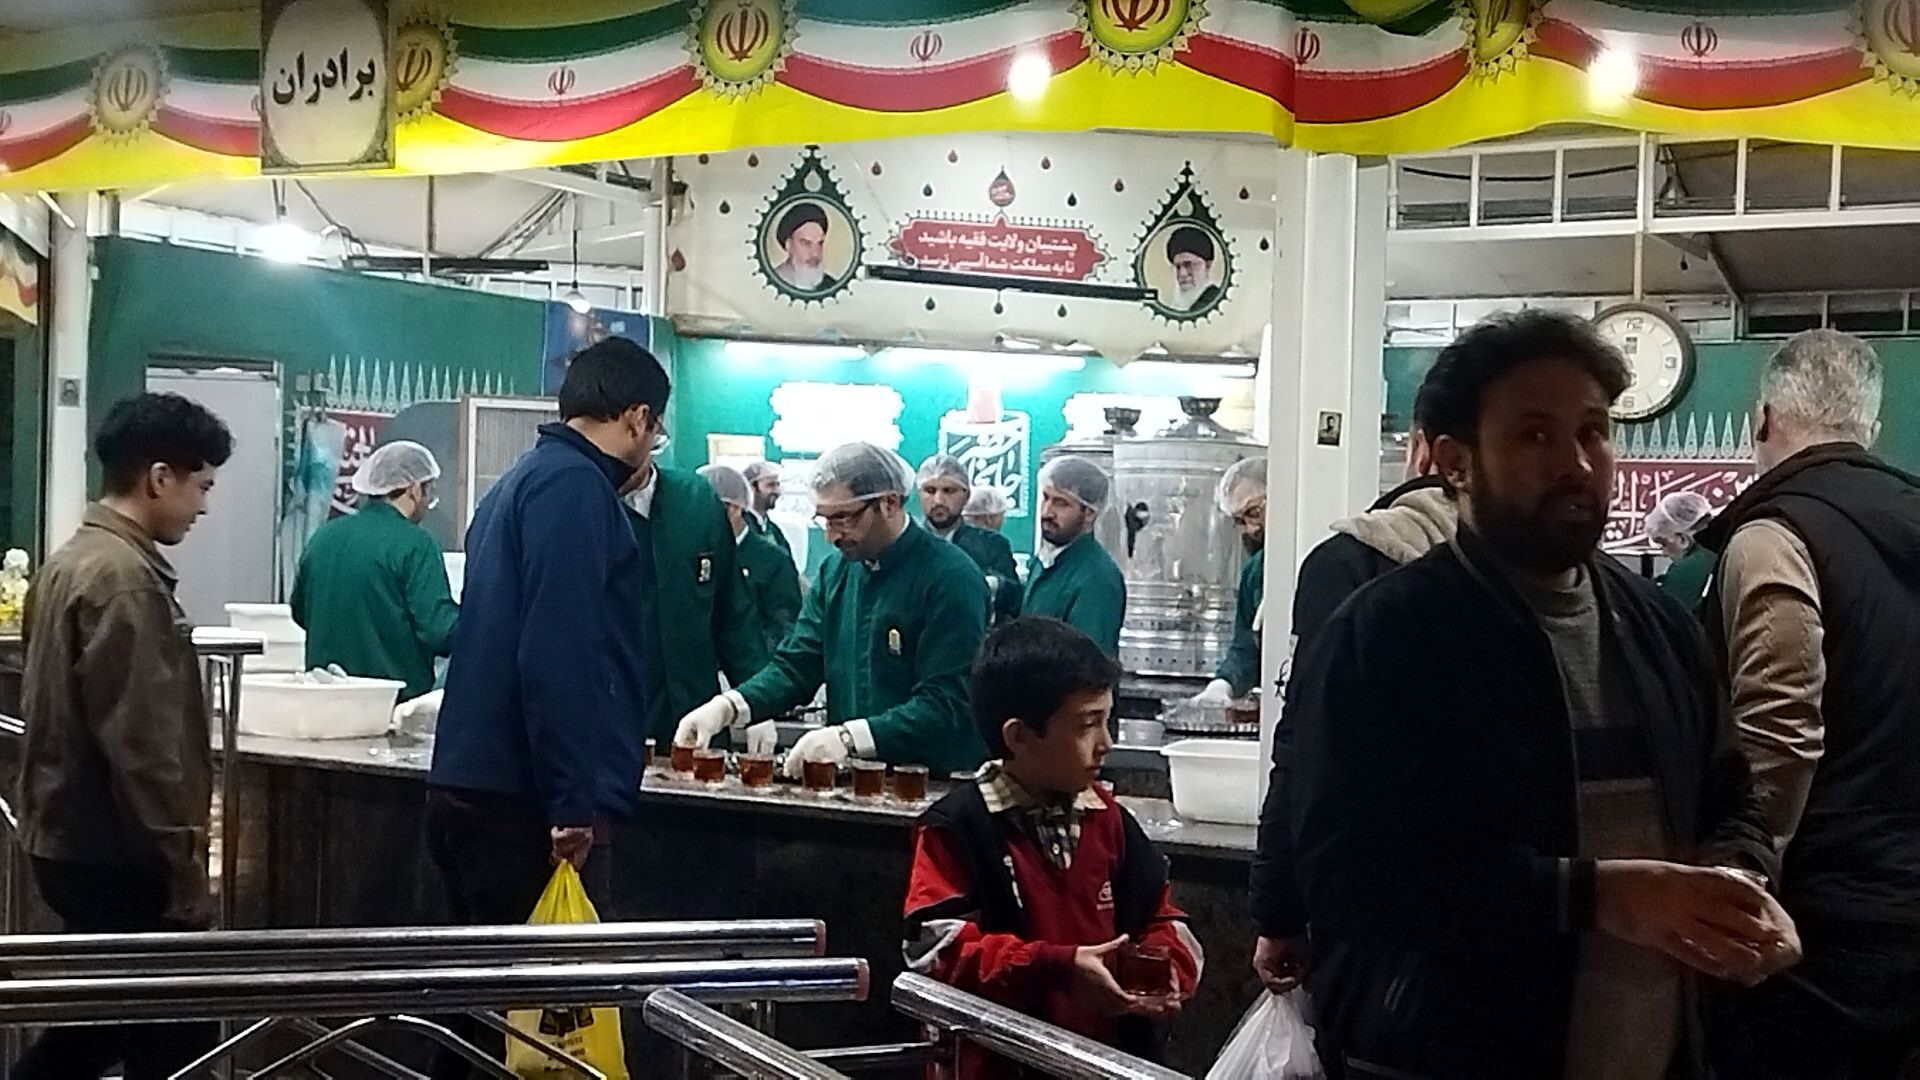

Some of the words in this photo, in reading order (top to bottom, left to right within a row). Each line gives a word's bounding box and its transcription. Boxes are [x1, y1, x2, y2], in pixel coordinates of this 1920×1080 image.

[272, 46, 376, 106] برادران
[918, 229, 958, 249] باشید
[958, 230, 987, 250] فقیه
[987, 232, 1024, 254] ولایت
[1025, 234, 1078, 258] پشتیبان
[984, 255, 1009, 270] شما
[1009, 257, 1052, 272] مملکت
[1624, 316, 1644, 329] 12
